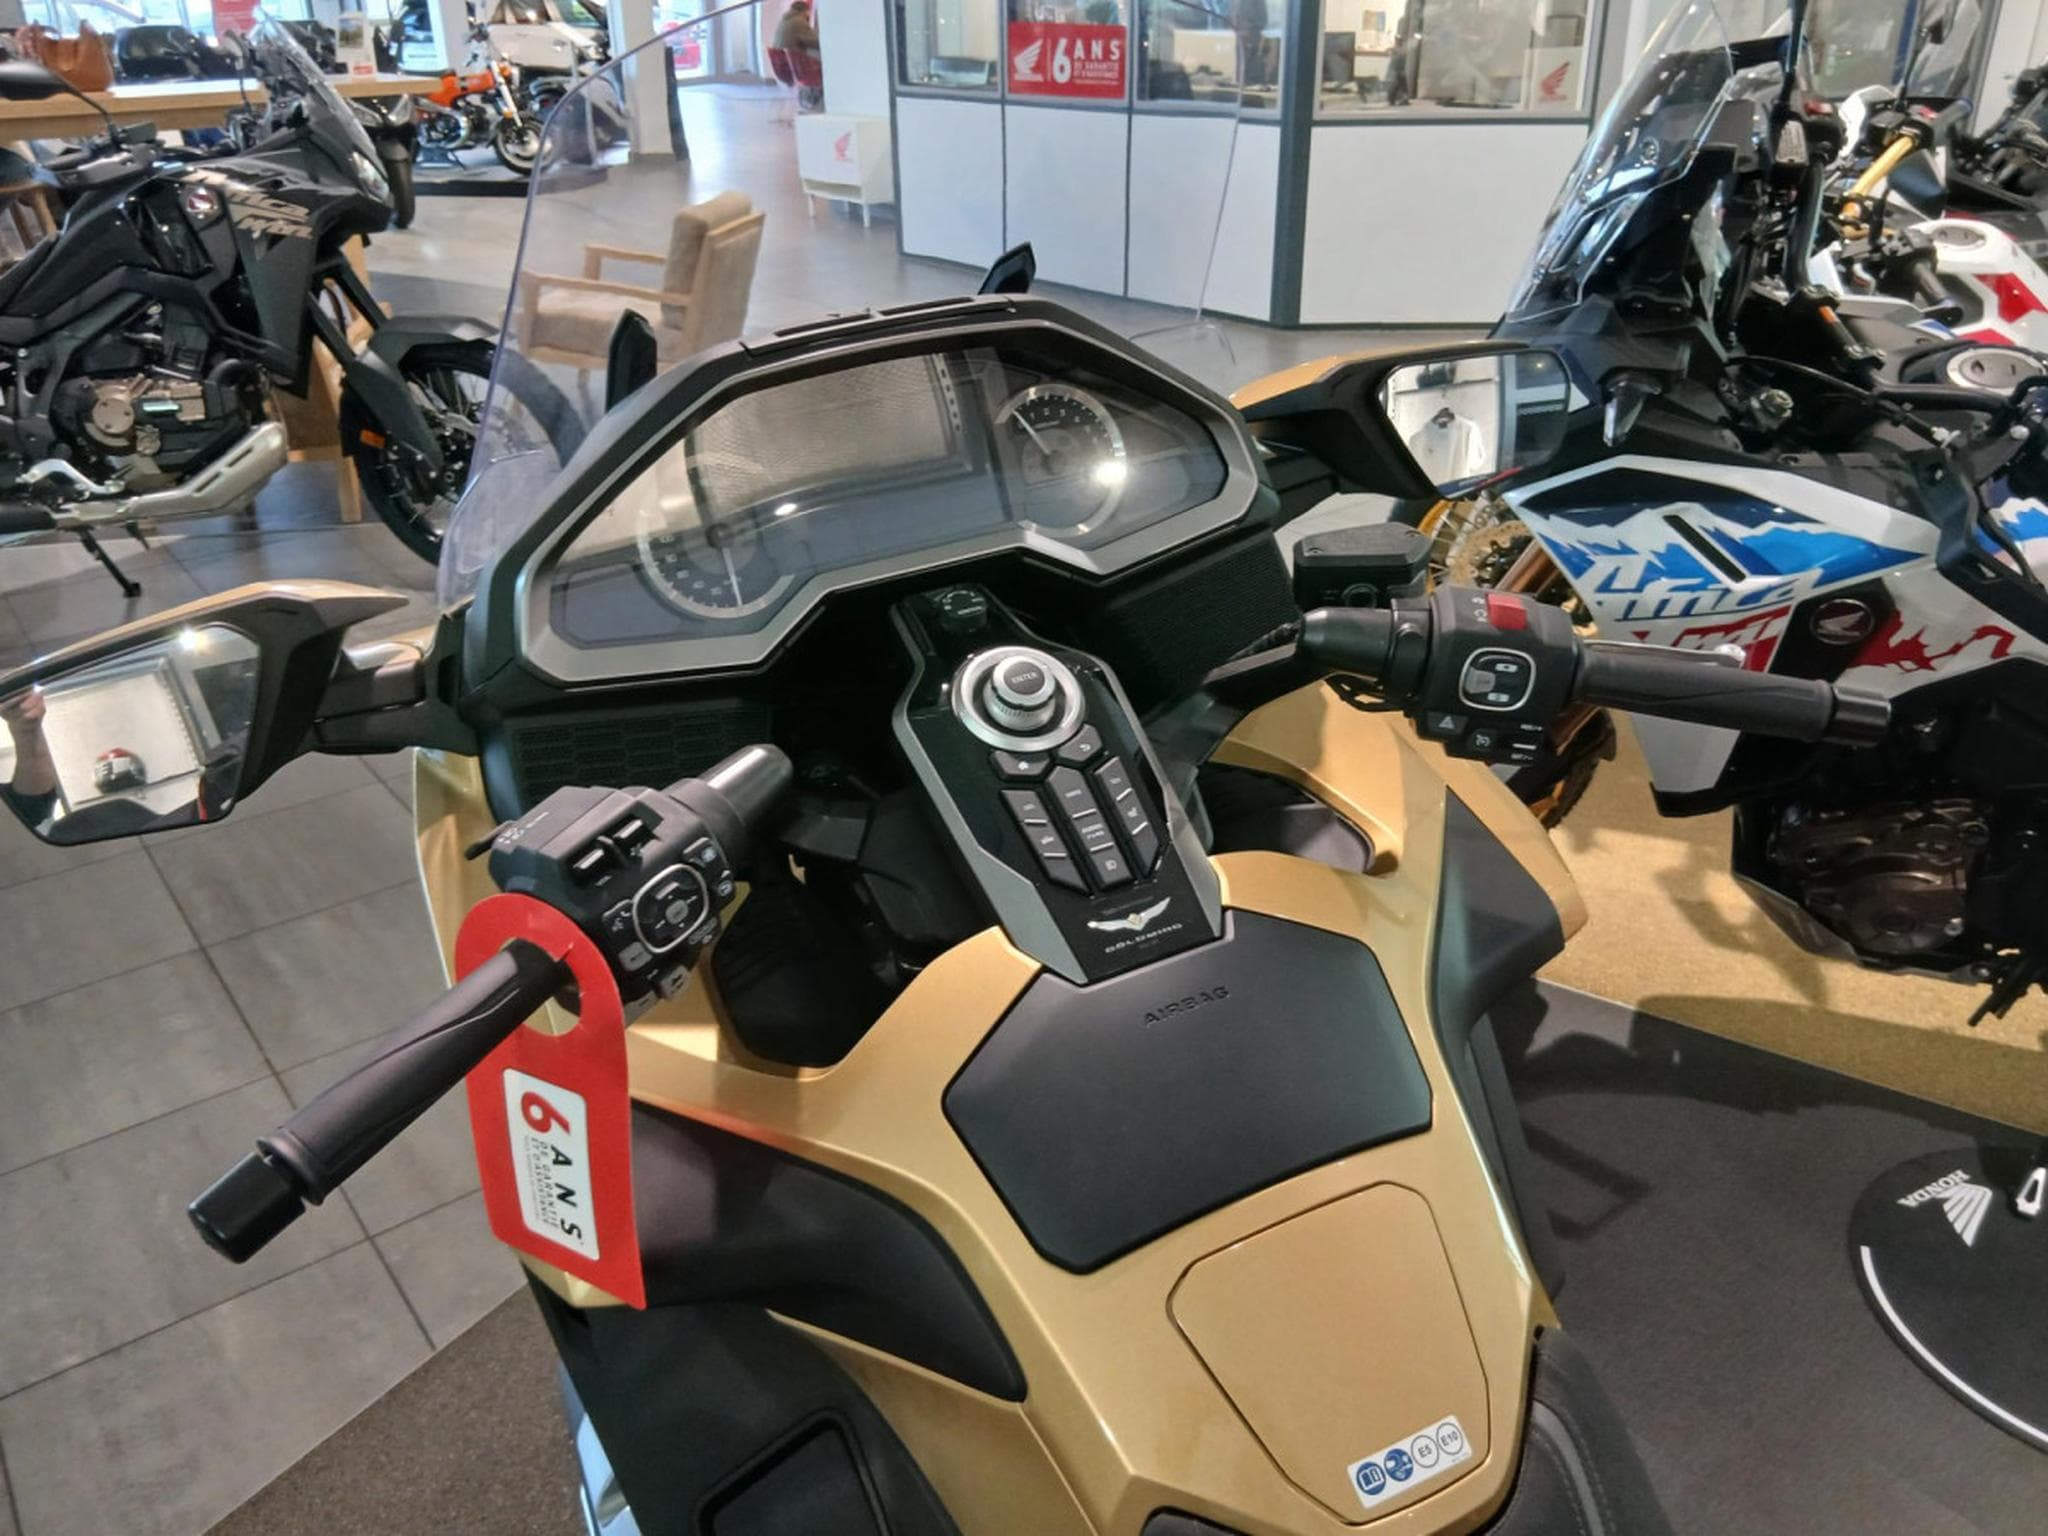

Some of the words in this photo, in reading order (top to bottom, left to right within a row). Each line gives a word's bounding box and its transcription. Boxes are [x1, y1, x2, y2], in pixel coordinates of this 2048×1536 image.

[1053, 37, 1071, 84] 6
[1073, 38, 1120, 60] ANS
[1145, 986, 1230, 1025] AIRBAG
[521, 1091, 571, 1135] 6
[550, 1144, 582, 1239] ANS
[1896, 1168, 1971, 1207] HONDA
[1417, 1443, 1433, 1459] E5
[1440, 1430, 1459, 1447] E10
